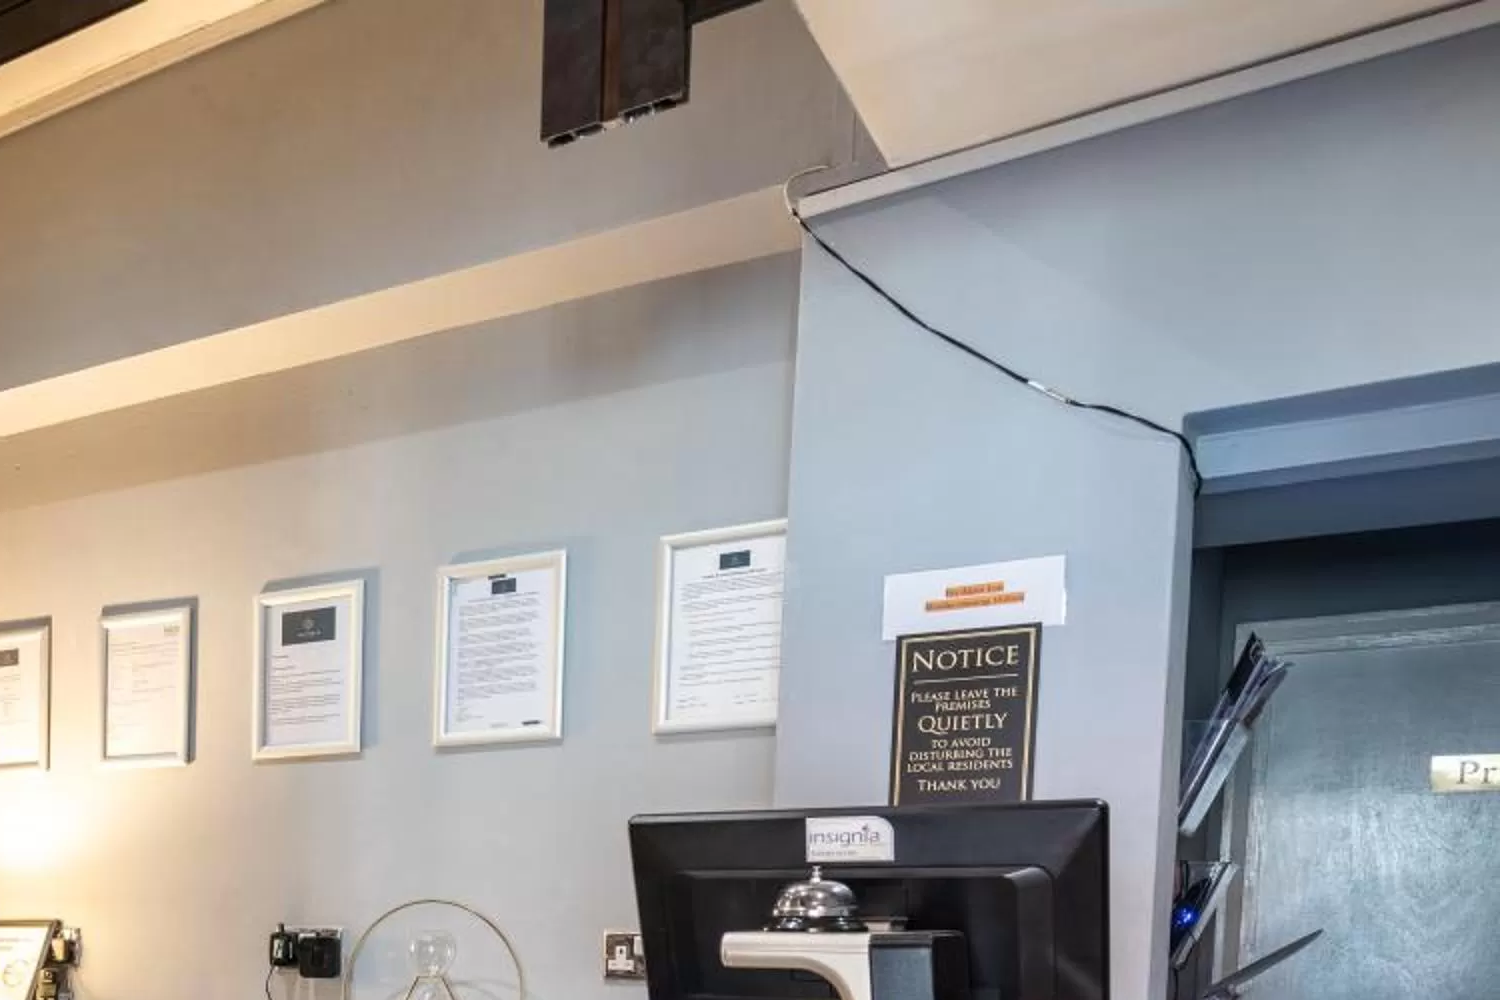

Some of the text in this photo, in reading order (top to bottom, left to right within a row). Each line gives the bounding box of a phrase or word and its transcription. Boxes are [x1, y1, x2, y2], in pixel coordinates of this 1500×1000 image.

[911, 644, 1019, 672] NOTICE
[911, 686, 1018, 702] PLEASE LEAVE THE
[935, 699, 991, 712] PREMISES
[917, 712, 1008, 734] QUIETLY
[931, 737, 991, 748] TO AVOID
[908, 747, 1012, 761] DISTURBING THE
[907, 758, 1012, 773] LOCAL RESIDENTS
[916, 776, 1000, 792] THANK YOU
[809, 823, 881, 848] insignia
